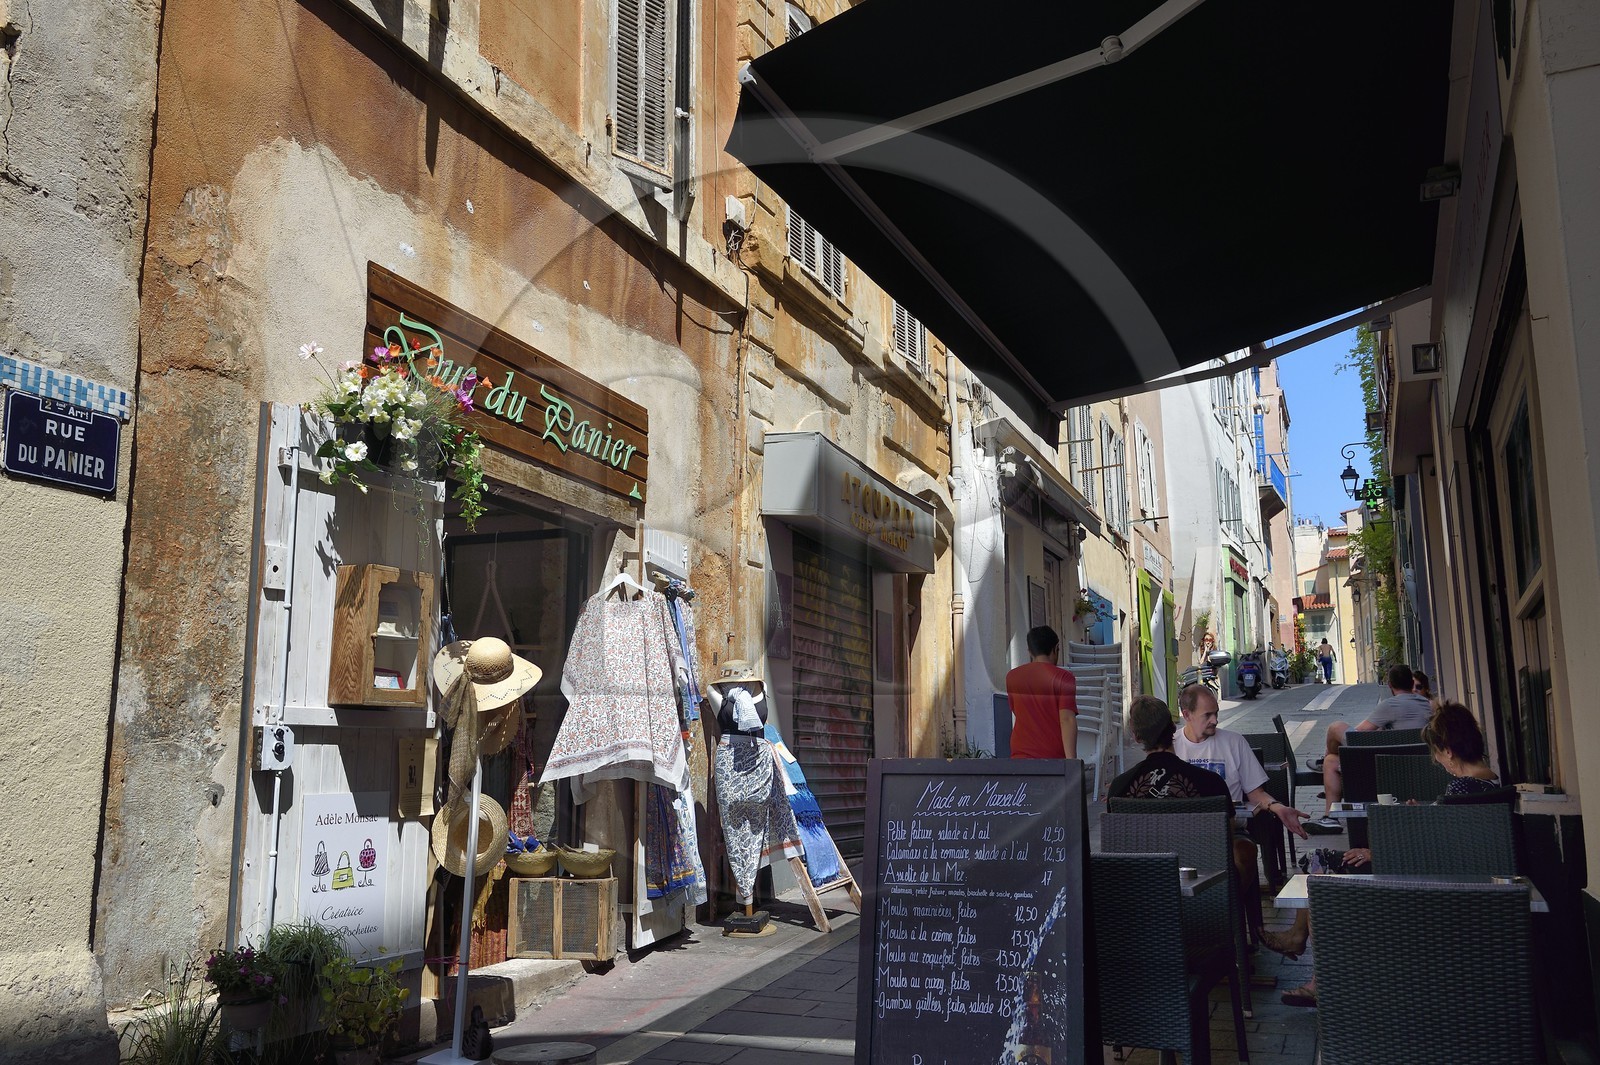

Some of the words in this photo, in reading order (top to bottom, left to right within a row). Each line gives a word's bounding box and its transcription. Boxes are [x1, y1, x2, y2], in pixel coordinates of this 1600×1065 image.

[45, 418, 86, 442] RUE
[485, 372, 527, 424] du
[540, 384, 636, 471] Panier
[18, 443, 37, 464] DU
[44, 445, 105, 480] PANIER
[916, 780, 957, 811] Made
[957, 792, 971, 808] in
[315, 813, 343, 826] Adèle
[963, 827, 968, 840] à
[923, 845, 929, 860] à
[930, 842, 938, 860] la
[1001, 847, 1008, 861] à
[920, 864, 929, 882] de
[932, 862, 941, 881] la
[1041, 871, 1053, 886] 17
[989, 889, 995, 897] de
[1013, 890, 1033, 900] gambas
[321, 905, 365, 921] Créatrice
[1015, 905, 1038, 923] 12,50
[911, 926, 918, 940] à
[919, 921, 927, 941] la
[1011, 930, 1035, 947] 13,50
[909, 951, 919, 963] au
[996, 949, 1021, 968] 13,50
[910, 975, 921, 988] au
[995, 974, 1019, 993] 13,50
[969, 993, 994, 1014] salade
[998, 998, 1012, 1018] 18
